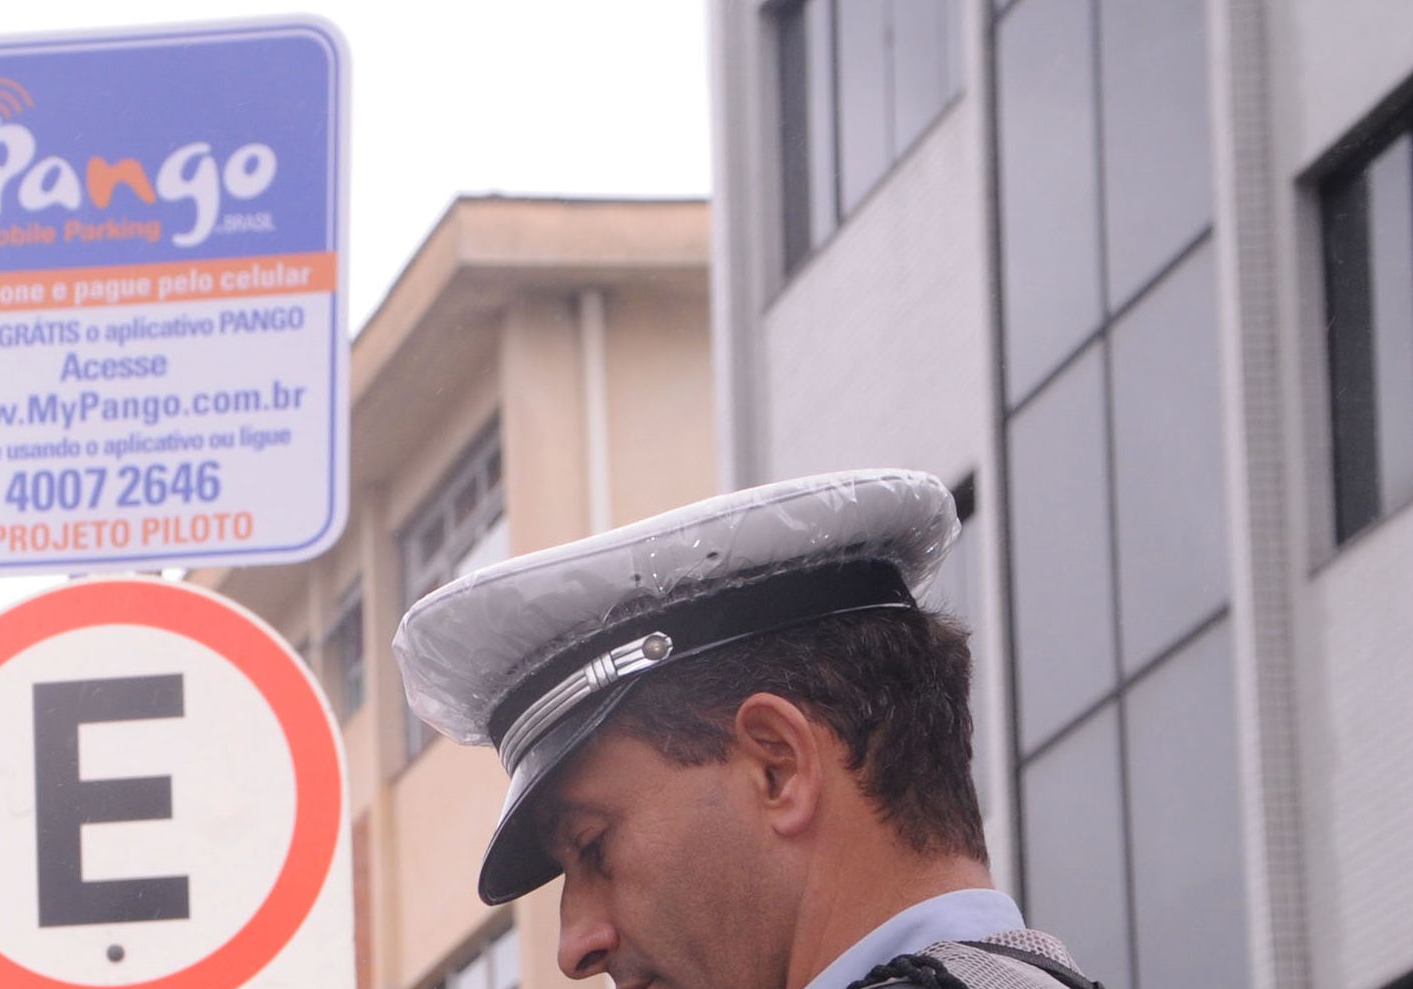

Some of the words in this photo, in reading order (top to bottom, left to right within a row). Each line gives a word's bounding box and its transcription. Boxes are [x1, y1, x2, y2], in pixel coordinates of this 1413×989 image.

[64, 220, 161, 243] Parking
[51, 284, 67, 301] e
[73, 273, 154, 306] pague
[159, 269, 214, 302] pelo
[220, 264, 310, 291] celular
[86, 326, 100, 343] o
[104, 315, 215, 347] aplicativo
[219, 306, 304, 334] PANGO
[60, 352, 168, 382] Acesse
[7, 437, 81, 460] usando
[85, 440, 99, 457] o
[103, 433, 205, 456] aplicativo
[209, 433, 235, 449] ou
[239, 426, 291, 451] ligue
[5, 467, 107, 512] 4007
[116, 461, 220, 507] 2646
[142, 512, 253, 545] PILOTO
[34, 673, 189, 928] E
